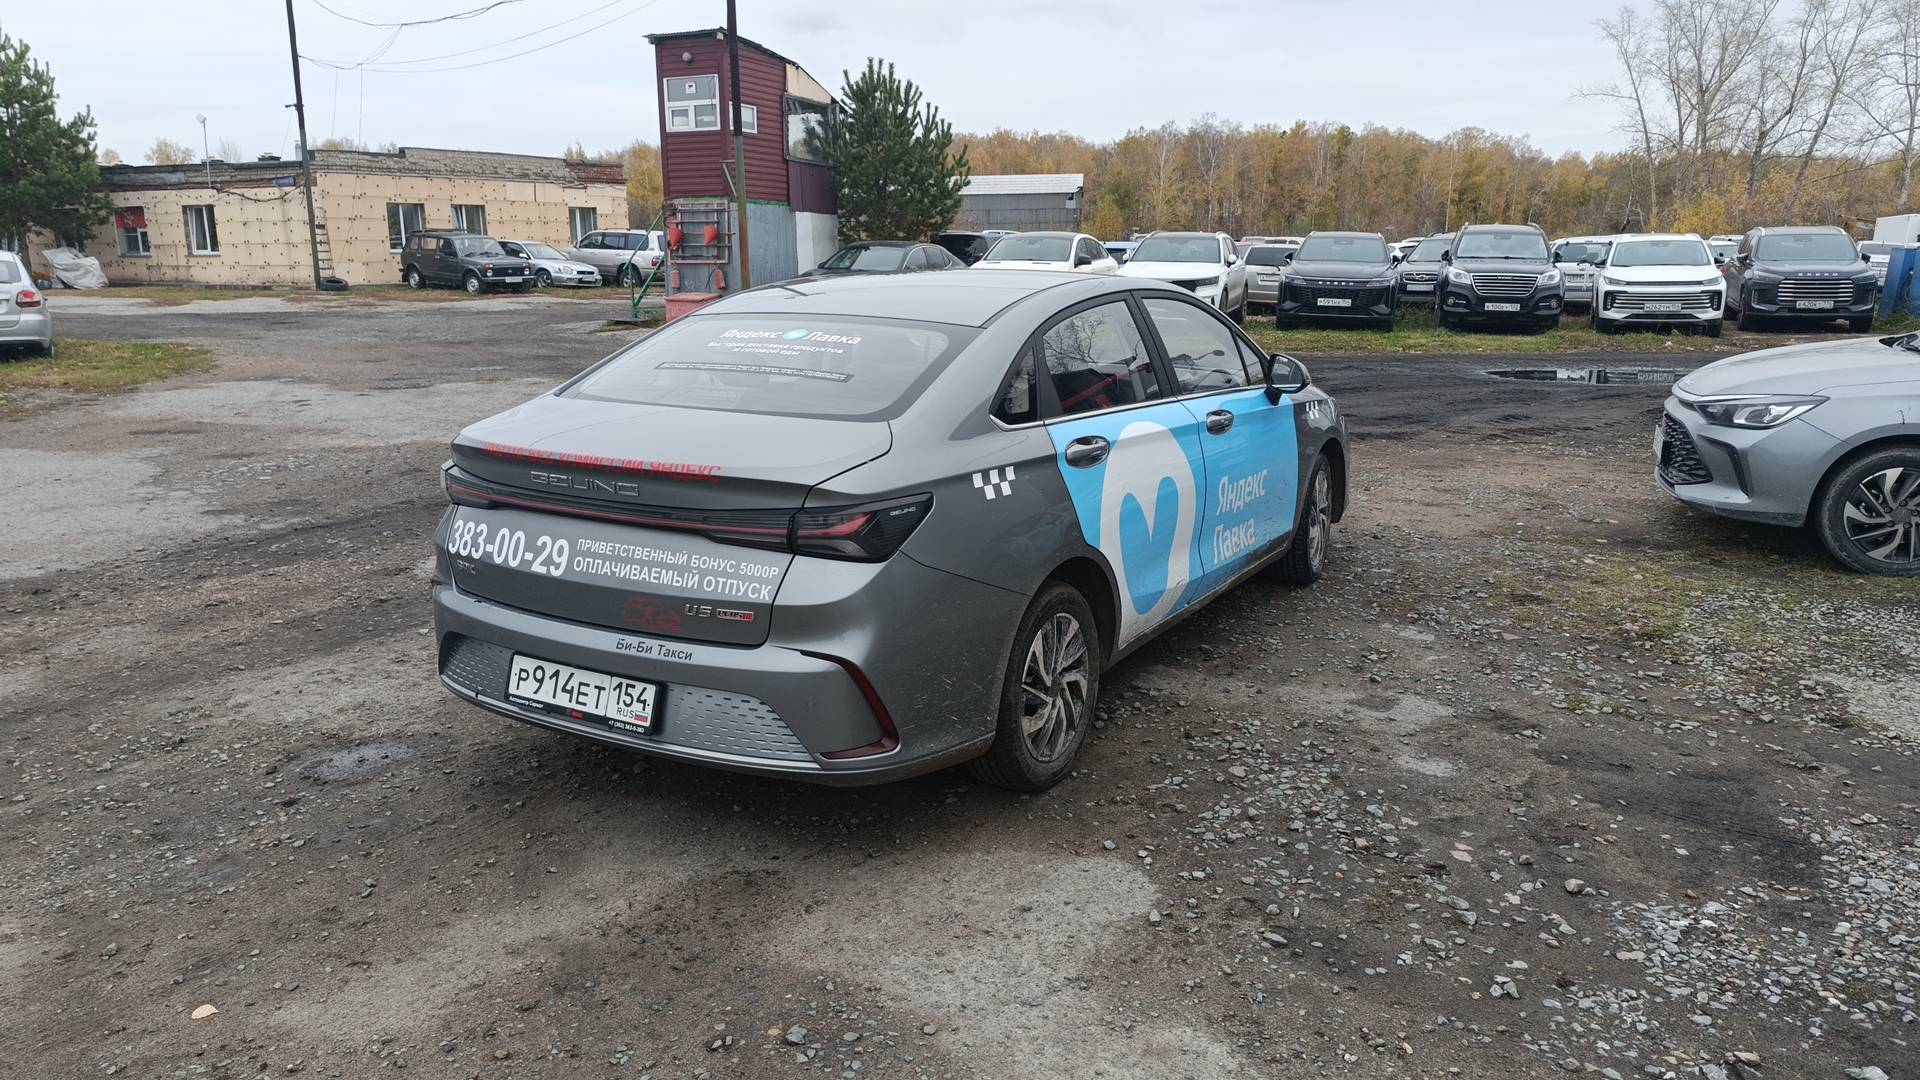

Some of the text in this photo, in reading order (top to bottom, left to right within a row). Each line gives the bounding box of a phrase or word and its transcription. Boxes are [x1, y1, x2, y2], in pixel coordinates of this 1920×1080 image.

[718, 328, 863, 345] Яндекс Лавка
[530, 471, 640, 497] BEIJING
[650, 461, 721, 486] ЯНДЕКС
[1215, 468, 1268, 516] Яндекс
[448, 519, 570, 577] 383-00-29
[576, 538, 779, 579] ПРИВЕТСТВЕННЫЙ БОНУС 5000Р
[1213, 518, 1256, 565] Лавка
[573, 556, 772, 600] ОПЛАЧИВАЕМЫЙ ОТПУСК
[616, 637, 693, 661] Би-Би Такси
[516, 664, 648, 711] Р914ЕТ 154
[616, 706, 635, 719] RUS
